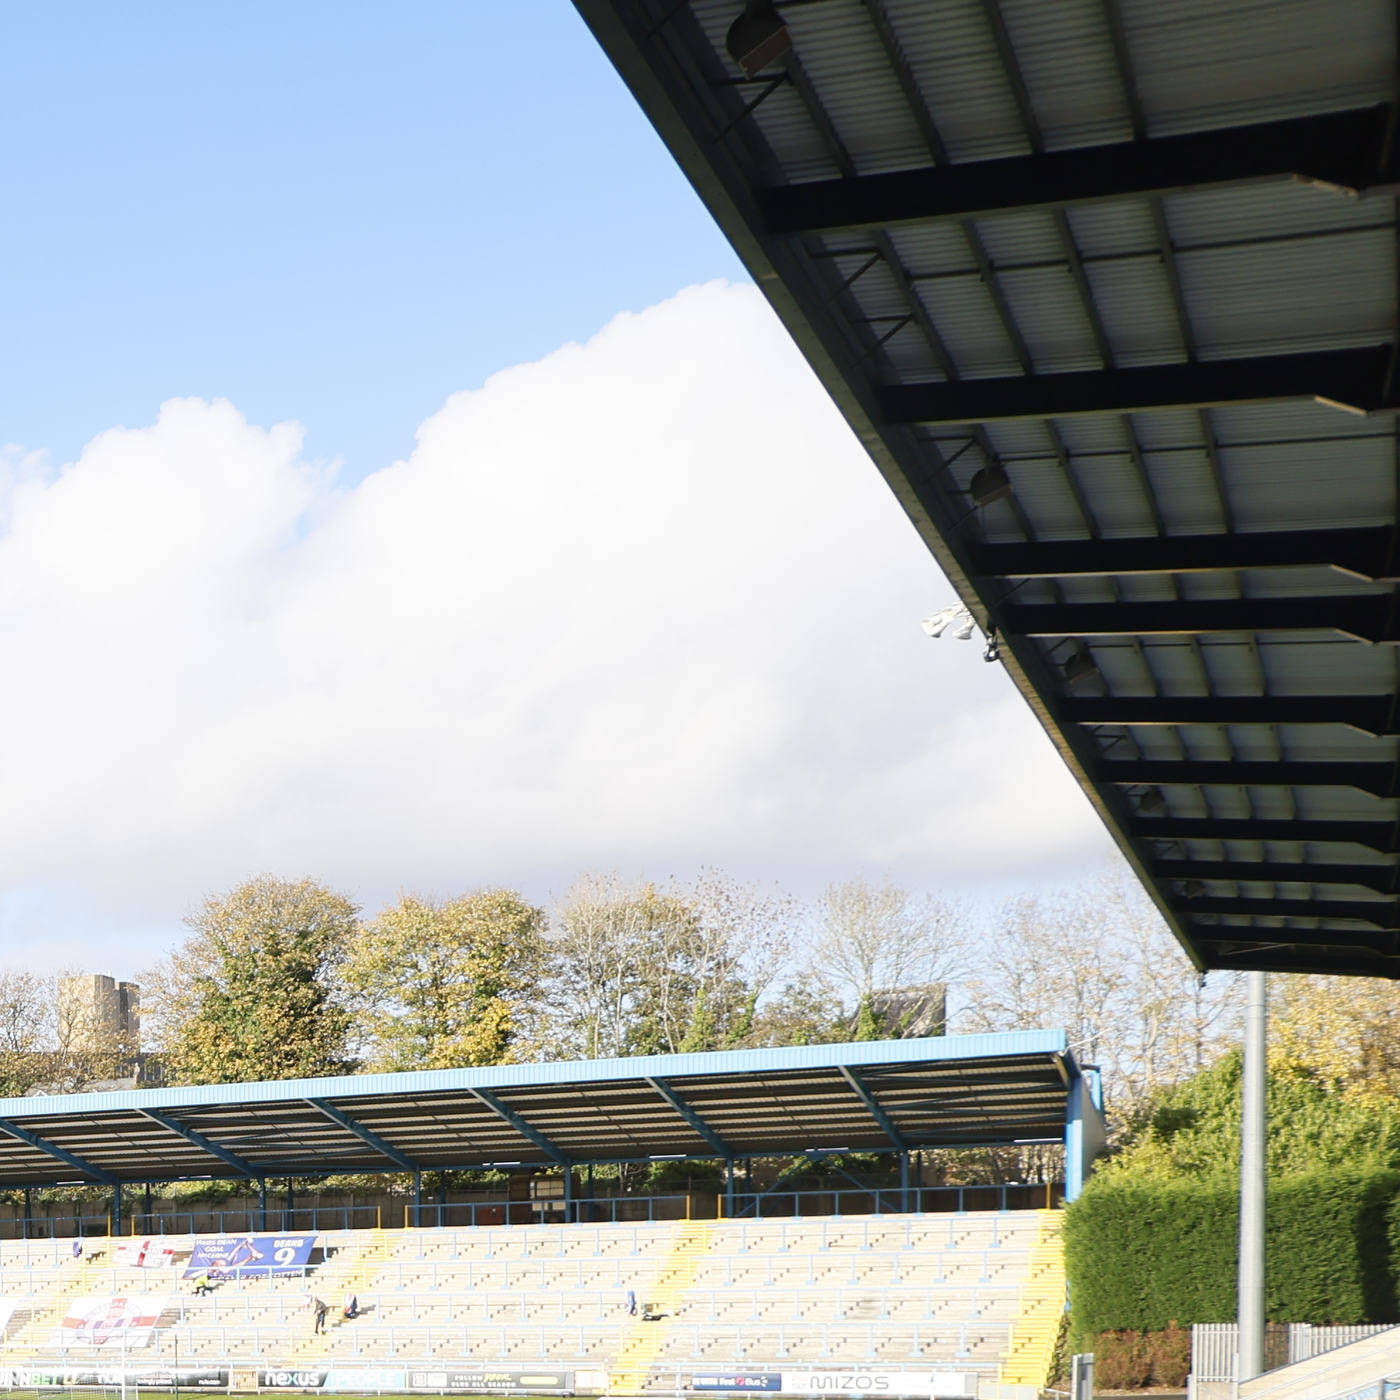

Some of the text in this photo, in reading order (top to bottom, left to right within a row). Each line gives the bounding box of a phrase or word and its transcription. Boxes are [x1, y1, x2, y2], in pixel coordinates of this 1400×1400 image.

[274, 1247, 296, 1267] 9
[265, 1371, 319, 1386] nexus
[335, 1372, 395, 1386] PEOPLE
[810, 1376, 889, 1389] MIZOS
